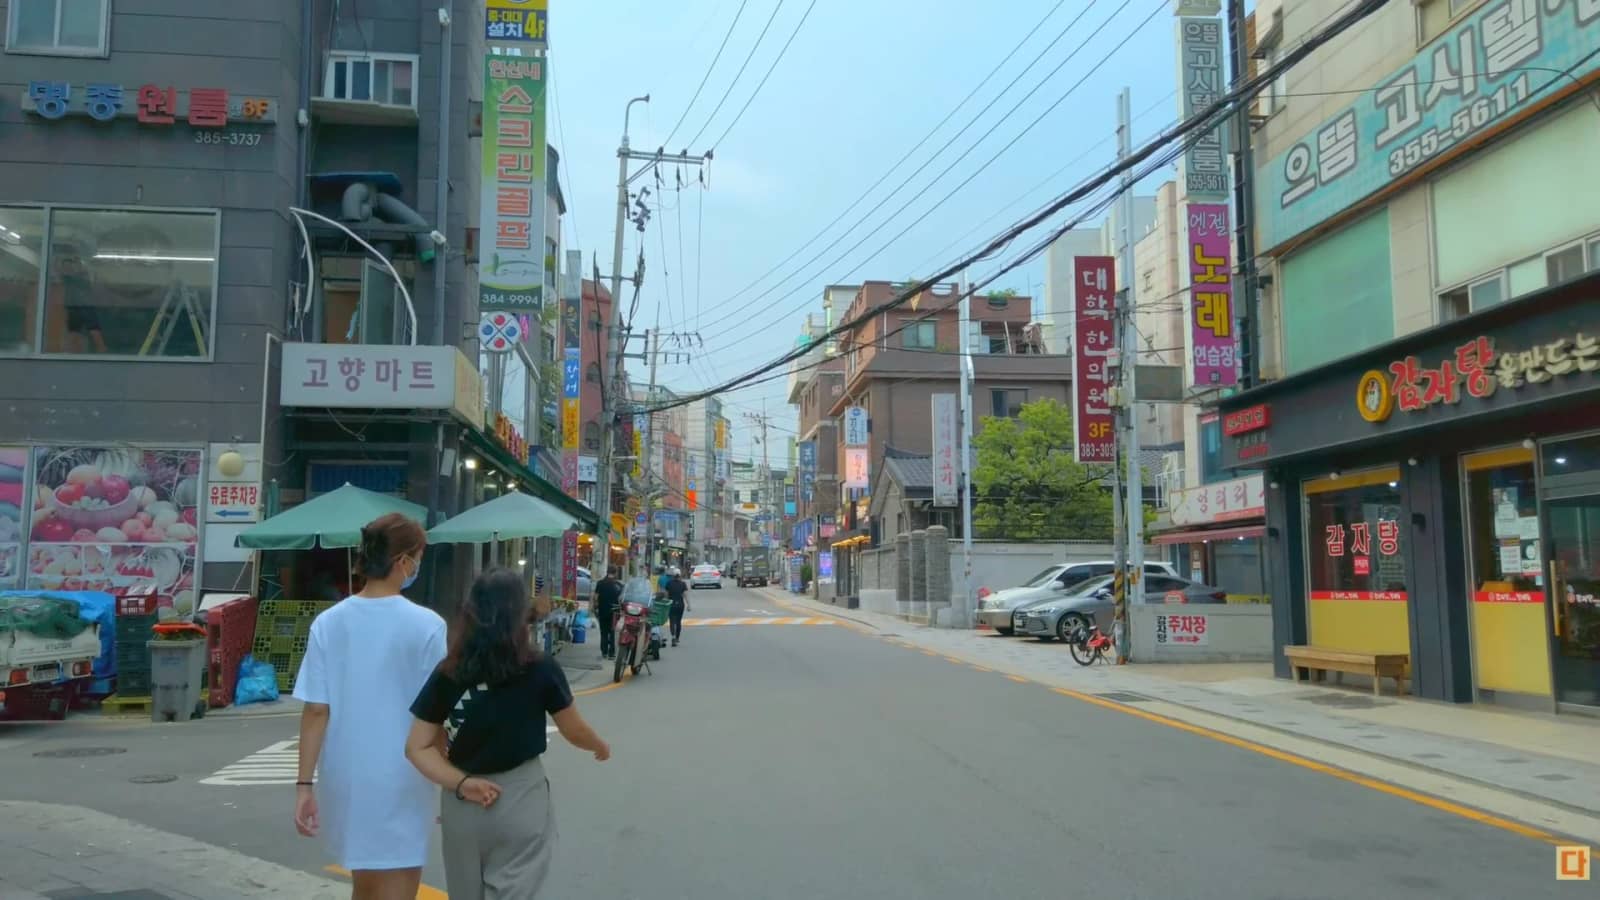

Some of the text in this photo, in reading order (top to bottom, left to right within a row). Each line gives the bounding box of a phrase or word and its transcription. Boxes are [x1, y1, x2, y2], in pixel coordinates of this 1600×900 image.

[488, 23, 523, 37] 설치
[1186, 23, 1218, 42] 으뜸
[1281, 0, 1544, 209] 으뜸 고시텔
[1389, 72, 1530, 176] 355-5611
[195, 131, 261, 146] 385-3737
[495, 85, 533, 249] 스크린골프
[1187, 174, 1227, 191] 355-5611
[1190, 212, 1228, 236] 엔젤
[1194, 243, 1229, 337] 노래
[1195, 345, 1235, 367] 연습장
[302, 357, 435, 392] 고향마트
[1390, 336, 1495, 411] 감자탕
[1088, 423, 1110, 438] 3F
[211, 486, 257, 505] 유료주차장
[1326, 520, 1398, 556] 감자탕
[1168, 616, 1206, 634] 주차장
